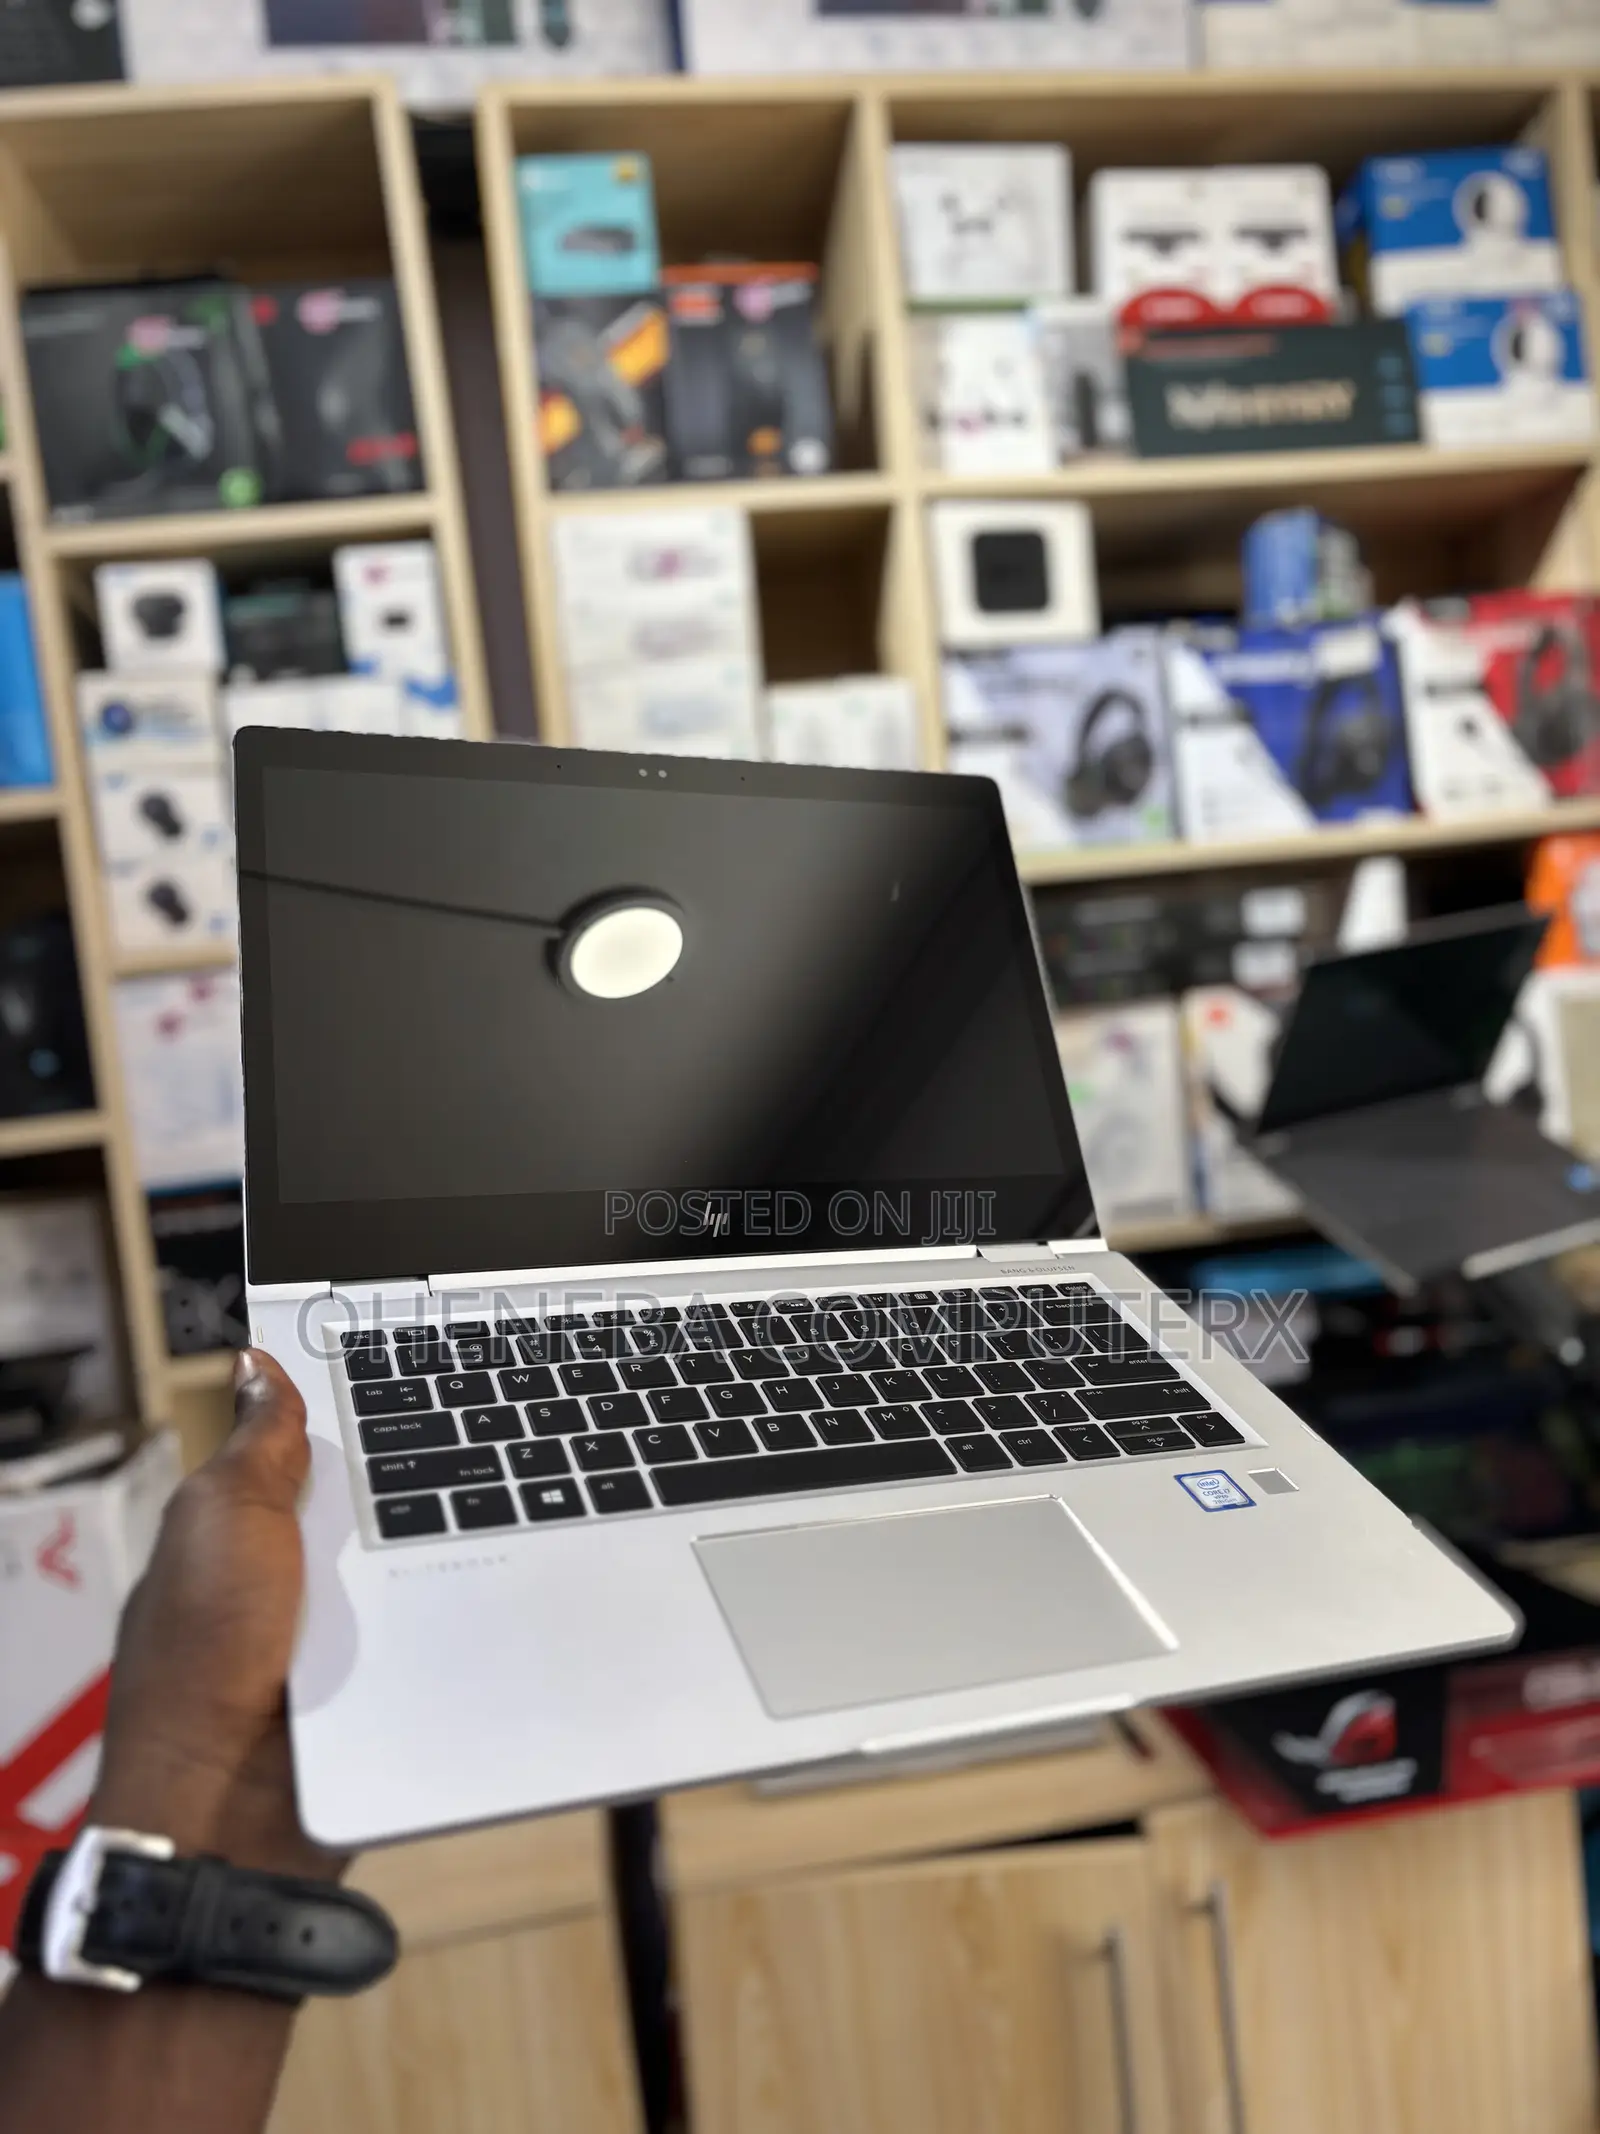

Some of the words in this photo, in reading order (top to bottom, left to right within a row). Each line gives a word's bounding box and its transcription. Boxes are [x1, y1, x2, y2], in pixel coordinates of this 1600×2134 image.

[474, 1354, 484, 1363] 2
[534, 1350, 543, 1358] 3
[797, 1351, 808, 1359] U
[687, 1359, 696, 1367] T
[743, 1355, 753, 1363] Y
[630, 1364, 643, 1373] R
[572, 1369, 583, 1378] E
[936, 1373, 948, 1382] L
[512, 1374, 530, 1383] W
[884, 1377, 897, 1386] K
[450, 1381, 464, 1389] Q
[832, 1382, 840, 1390] J
[720, 1390, 732, 1399] G
[775, 1386, 788, 1395] H
[661, 1395, 671, 1404] F
[601, 1402, 614, 1411] D
[540, 1408, 551, 1417] S
[881, 1412, 896, 1422] M
[478, 1415, 491, 1424] A
[825, 1417, 838, 1426] N
[374, 1425, 397, 1433] caps
[400, 1422, 421, 1430] lock
[767, 1423, 780, 1432] B
[708, 1428, 720, 1438] V
[648, 1434, 661, 1444] C
[1017, 1438, 1032, 1446] ctrl
[585, 1441, 598, 1451] X
[520, 1448, 533, 1459] Z
[381, 1462, 404, 1471] shift
[473, 1466, 495, 1475] lock
[601, 1481, 615, 1490] alt
[1202, 1488, 1222, 1496] CORE
